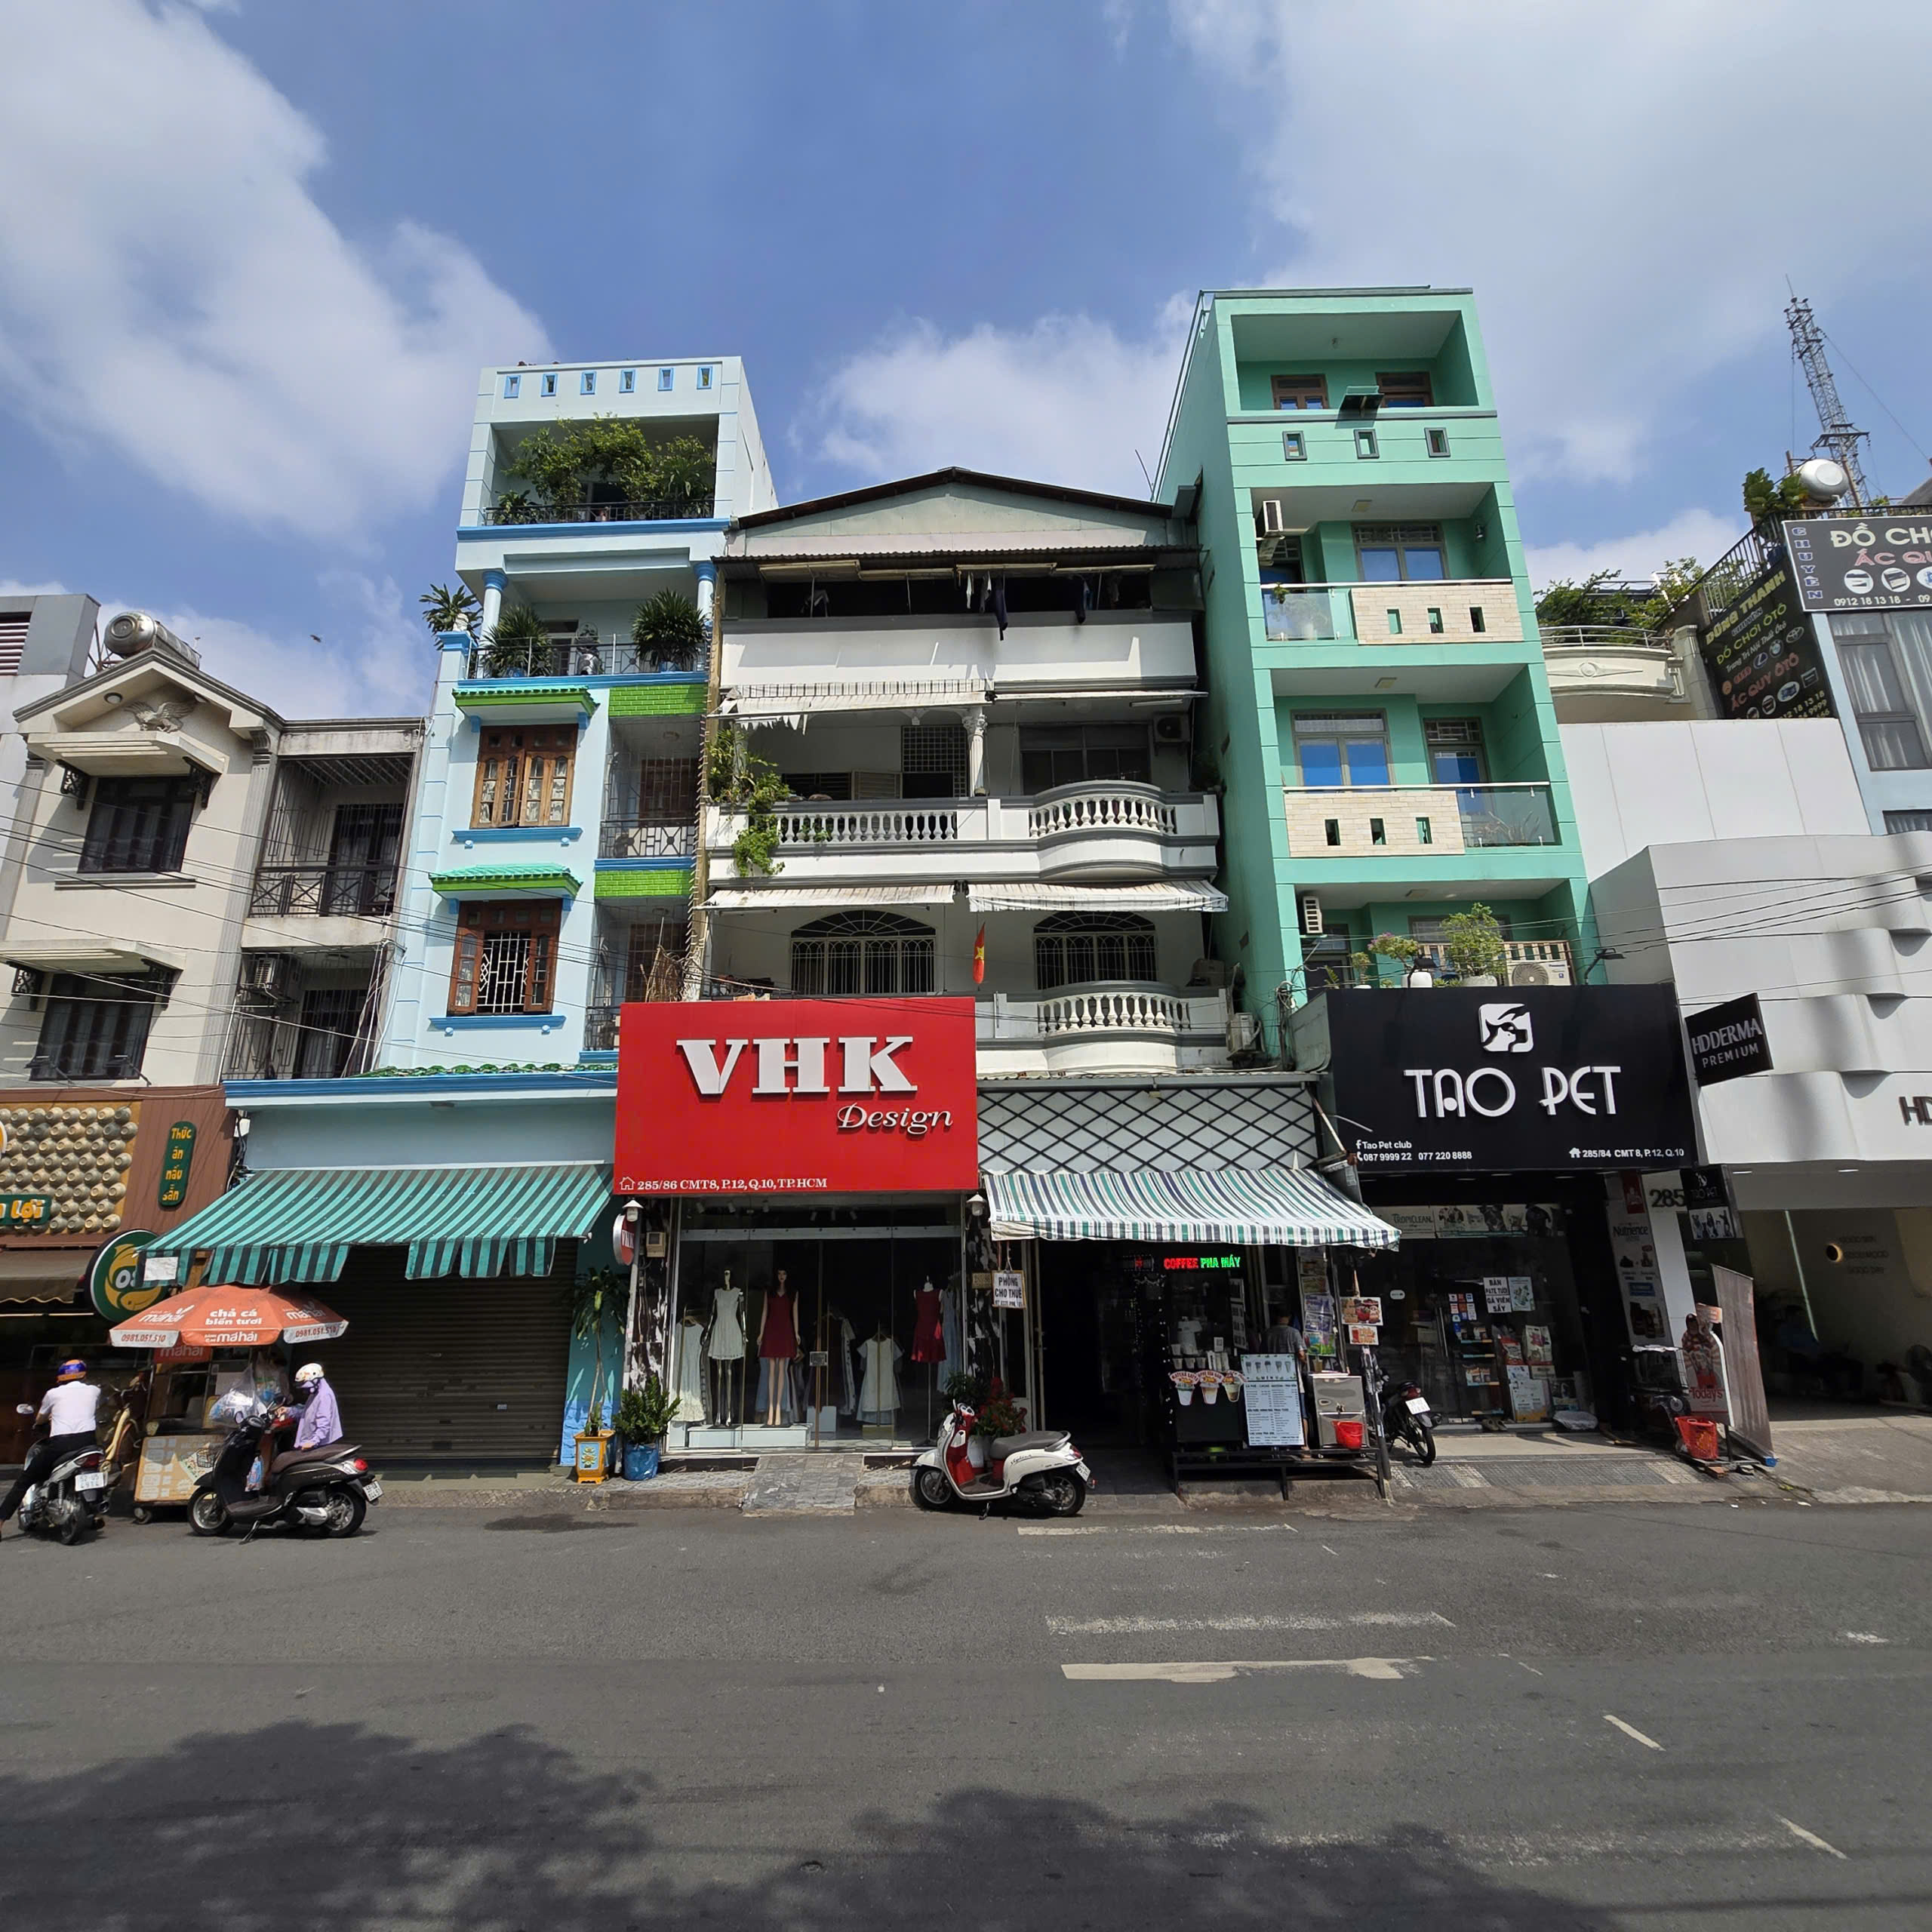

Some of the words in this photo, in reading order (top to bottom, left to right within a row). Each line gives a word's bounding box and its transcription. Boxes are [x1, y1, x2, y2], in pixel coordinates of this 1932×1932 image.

[1885, 527, 1932, 545] CH
[1740, 570, 1786, 614] THANH
[1834, 597, 1859, 606] 0912
[1860, 597, 1872, 605] 18
[1875, 596, 1887, 605] 13
[1889, 595, 1901, 604] 18
[1691, 1017, 1763, 1055] HDDERMA
[1702, 1042, 1759, 1069] PREMIUM
[676, 1036, 918, 1095] VHK
[1403, 1066, 1516, 1118] TAO
[1539, 1066, 1621, 1116] PET
[837, 1102, 953, 1136] Design
[1361, 1141, 1377, 1149] Tao
[1378, 1140, 1392, 1149] Pet
[1394, 1140, 1412, 1149] club
[1363, 1153, 1377, 1161] 087
[1380, 1152, 1400, 1161] 9999
[1401, 1152, 1412, 1161] 22
[1418, 1152, 1434, 1161] 077
[1435, 1152, 1451, 1160] 220
[1452, 1151, 1472, 1160] 8888
[1583, 1149, 1612, 1158] 285/84
[1665, 1148, 1684, 1157] Q.10
[637, 1180, 678, 1190] 285/86
[680, 1179, 719, 1191] CMT8,
[1164, 1257, 1199, 1269] COFFEE
[1200, 1257, 1220, 1269] PHA
[1220, 1254, 1241, 1269] MÁY
[995, 1288, 1008, 1298] CHO
[210, 1307, 236, 1318] chả
[241, 1309, 257, 1317] cá
[295, 1326, 337, 1338] 0981.051.510
[121, 1334, 166, 1343] 0981.051.510
